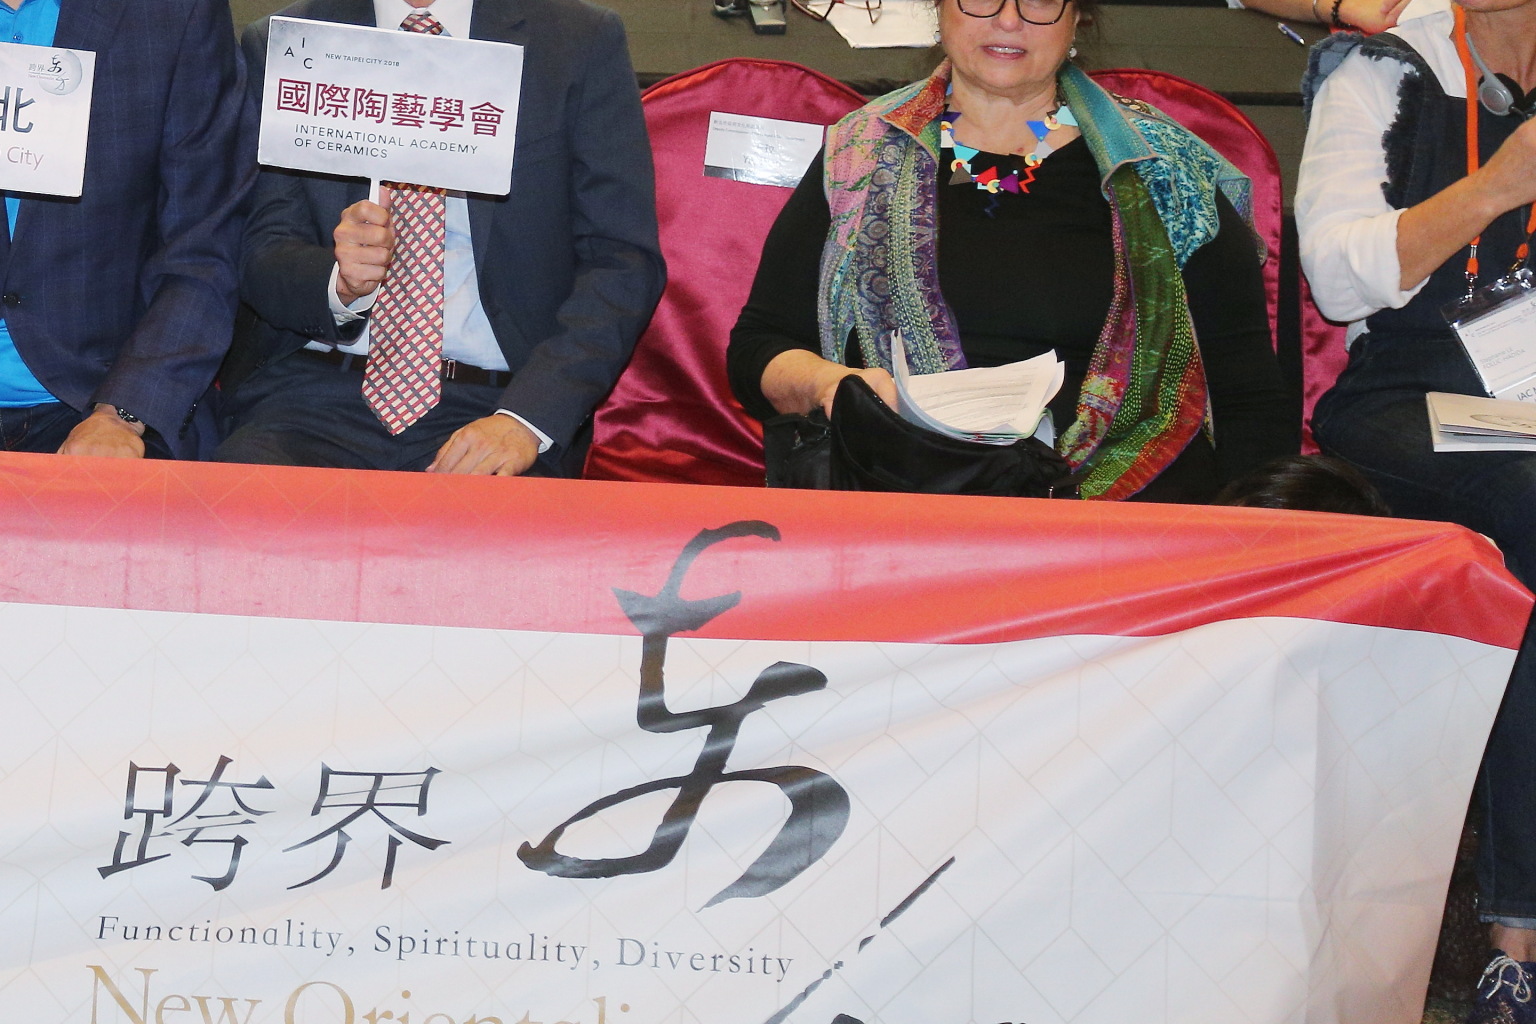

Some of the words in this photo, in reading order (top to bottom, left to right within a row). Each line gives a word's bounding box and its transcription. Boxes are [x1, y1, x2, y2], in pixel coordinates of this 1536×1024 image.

[284, 46, 295, 57] A
[303, 58, 313, 69] C
[325, 53, 342, 61] NEW
[343, 55, 365, 63] TAIPEI
[277, 78, 505, 137] 國際陶藝學會
[294, 138, 312, 148] OF
[317, 140, 388, 159] CERAMICS
[295, 124, 405, 147] INTERNATIONAL
[410, 139, 479, 155] ACADEMY
[7, 146, 44, 171] City
[97, 755, 452, 891] 跨界
[97, 916, 355, 956] Functionality,
[374, 925, 600, 970] Spirituality,
[616, 937, 794, 982] Diversity
[86, 965, 262, 1024] New
